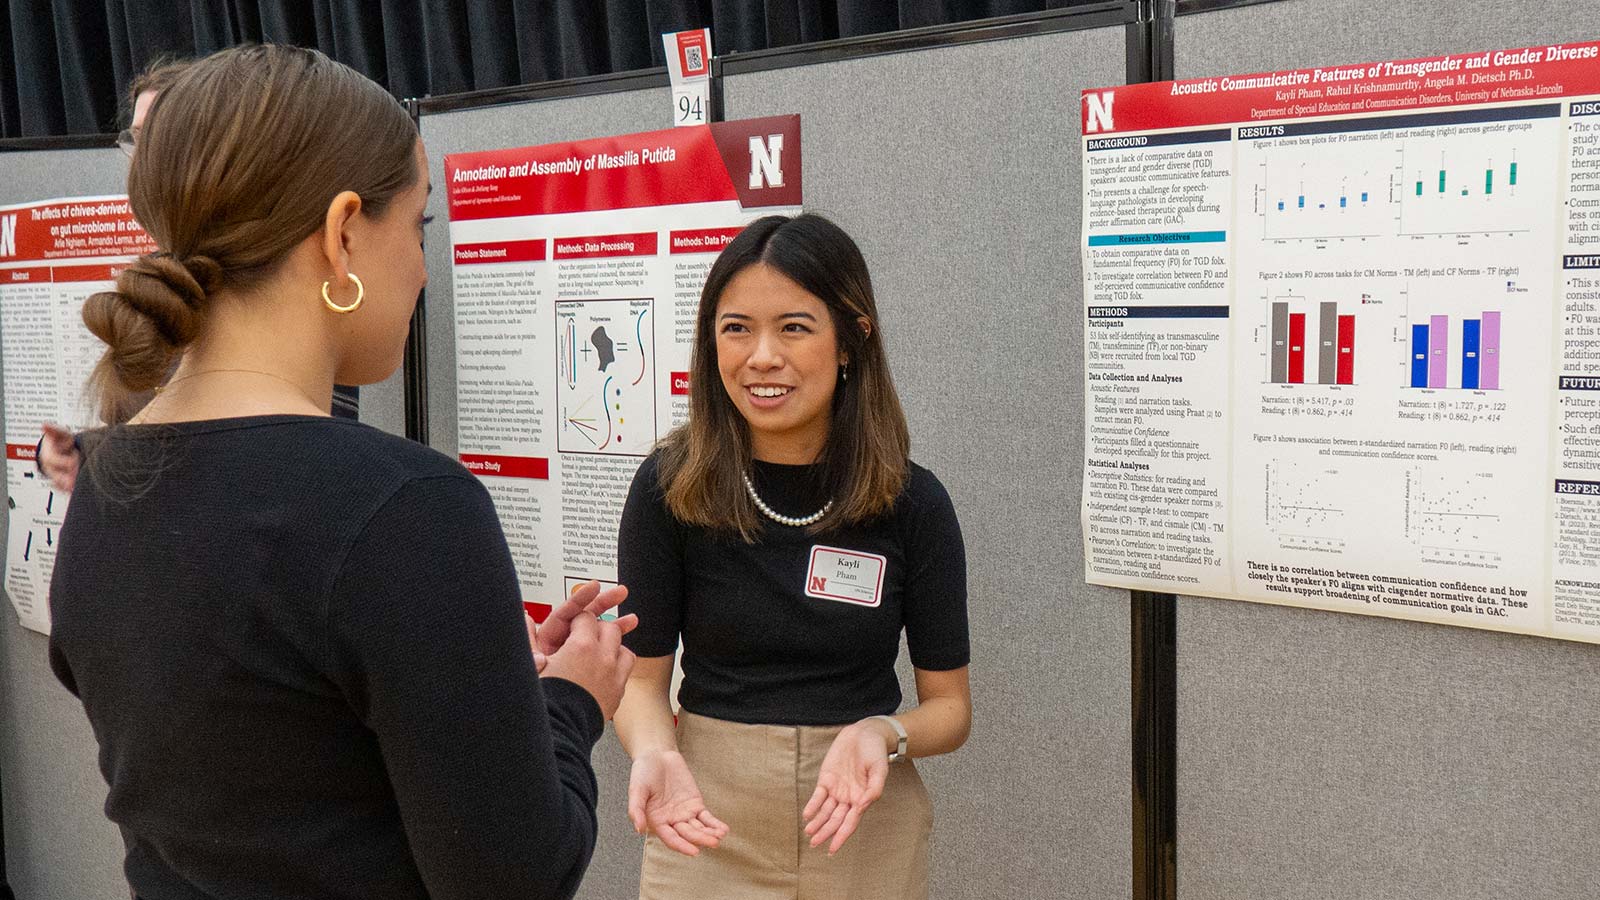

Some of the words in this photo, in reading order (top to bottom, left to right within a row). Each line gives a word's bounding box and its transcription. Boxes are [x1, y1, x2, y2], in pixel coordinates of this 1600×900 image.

[1171, 80, 1217, 95] Acoustic
[1221, 72, 1309, 91] Communicative
[1313, 68, 1364, 83] Features
[1368, 63, 1382, 77] of
[1384, 57, 1462, 77] Transgender
[1466, 53, 1490, 69] and
[1494, 50, 1542, 66] Gender
[1546, 46, 1598, 61] Diverse
[1276, 89, 1295, 102] Kayli
[1298, 88, 1323, 98] Pham,
[1326, 85, 1351, 96] Rahul
[1354, 79, 1421, 94] Krishnamurthy,
[1424, 76, 1454, 90] Angela
[1457, 75, 1468, 85] M.
[1472, 71, 1505, 84] Dietsch
[1509, 69, 1534, 81] Ph.D.
[679, 95, 702, 121] 94
[1251, 107, 1286, 120] Department
[1288, 105, 1294, 115] of
[1295, 103, 1316, 116] Special
[1319, 101, 1350, 112] Education
[1352, 100, 1364, 109] and
[1366, 96, 1417, 108] Communication
[1419, 93, 1453, 104] Disorders,
[1456, 90, 1489, 101] University
[1492, 88, 1499, 98] of
[1501, 83, 1563, 97] Nebraska-Lincoln
[1087, 91, 1114, 133] N
[1240, 125, 1284, 138] RESULTS
[1573, 122, 1590, 132] The
[1088, 137, 1147, 150] BACKGROUND
[1573, 134, 1599, 146] study
[749, 134, 784, 189] N
[1091, 156, 1106, 164] There
[1109, 155, 1113, 163] is
[1122, 154, 1134, 162] lack
[1137, 153, 1144, 161] of
[1145, 151, 1185, 162] comparative
[1187, 150, 1202, 158] data
[453, 165, 506, 182] Annotation
[509, 161, 528, 177] and
[530, 157, 582, 175] Assembly
[584, 155, 596, 169] of
[598, 151, 639, 168] Massilia
[642, 147, 675, 164] Putida
[1091, 165, 1126, 175] transgender
[1129, 164, 1140, 172] and
[1143, 163, 1165, 173] gender
[1167, 162, 1190, 170] diverse
[1193, 160, 1212, 171] (TGD)
[1120, 173, 1145, 182] acoustic
[1148, 170, 1199, 180] communicative
[1201, 170, 1231, 178] features.
[1091, 189, 1102, 197] This
[1104, 188, 1130, 198] presents
[1138, 186, 1169, 195] challenge
[1172, 185, 1180, 193] for
[1183, 184, 1208, 194] speech-
[1090, 199, 1116, 208] language
[1118, 197, 1157, 208] pathologists
[1160, 196, 1165, 204] in
[1168, 195, 1204, 204] developing
[31, 209, 41, 220] The
[42, 208, 60, 219] effects
[62, 206, 69, 218] of
[70, 202, 128, 217] chives-derived
[1090, 207, 1135, 217] evidence-based
[1138, 205, 1175, 216] therapeutic
[1178, 205, 1194, 215] goals
[1197, 204, 1220, 213] during
[1570, 210, 1586, 219] less
[51, 226, 59, 236] on
[60, 223, 71, 237] gut
[72, 221, 115, 234] microbiome
[118, 220, 124, 231] in
[1090, 219, 1109, 229] gender
[1111, 217, 1146, 226] affirmation
[1164, 216, 1185, 226] (GAC).
[1569, 222, 1588, 231] with
[0, 214, 16, 256] N
[88, 237, 113, 246] Armando
[136, 234, 147, 243] and
[674, 237, 703, 247] Methods:
[705, 236, 719, 244] Data
[1153, 234, 1190, 242] Objectives
[456, 249, 478, 258] Problem
[479, 248, 506, 257] Statement
[558, 244, 583, 253] Methods:
[585, 243, 599, 252] Data
[601, 241, 634, 252] Processing
[1572, 278, 1591, 287] This
[1090, 308, 1128, 316] METHODS
[1566, 302, 1596, 311] adults.
[1089, 320, 1123, 329] Participants
[1577, 326, 1594, 335] this
[1102, 373, 1134, 381] Collection
[1152, 374, 1182, 384] Analyses
[1565, 397, 1595, 406] Future
[1564, 424, 1587, 433] Such
[485, 461, 501, 472] Study
[838, 558, 860, 569] Kayli
[836, 570, 857, 580] Pham
[1247, 561, 1268, 570] There
[1271, 563, 1277, 571] is
[1292, 567, 1334, 577] correlation
[1337, 570, 1369, 581] between
[1372, 575, 1437, 588] communication
[1440, 581, 1487, 593] confidence
[1490, 586, 1506, 595] and
[1510, 587, 1527, 597] how
[812, 576, 826, 591] N
[1248, 571, 1274, 583] closely
[1276, 574, 1288, 582] the
[1292, 577, 1326, 586] speaker's
[1342, 581, 1364, 592] aligns
[1368, 584, 1385, 593] with
[1388, 586, 1427, 597] cisgender
[1430, 592, 1474, 603] normative
[1477, 595, 1499, 605] data.
[1502, 598, 1528, 608] These
[1266, 584, 1291, 593] results
[1295, 588, 1323, 597] support
[1326, 589, 1370, 604] broadening
[1373, 595, 1380, 603] of
[1383, 597, 1448, 610] communication
[1451, 604, 1472, 613] goals
[1475, 606, 1484, 614] in
[1487, 607, 1508, 617] GAC.
